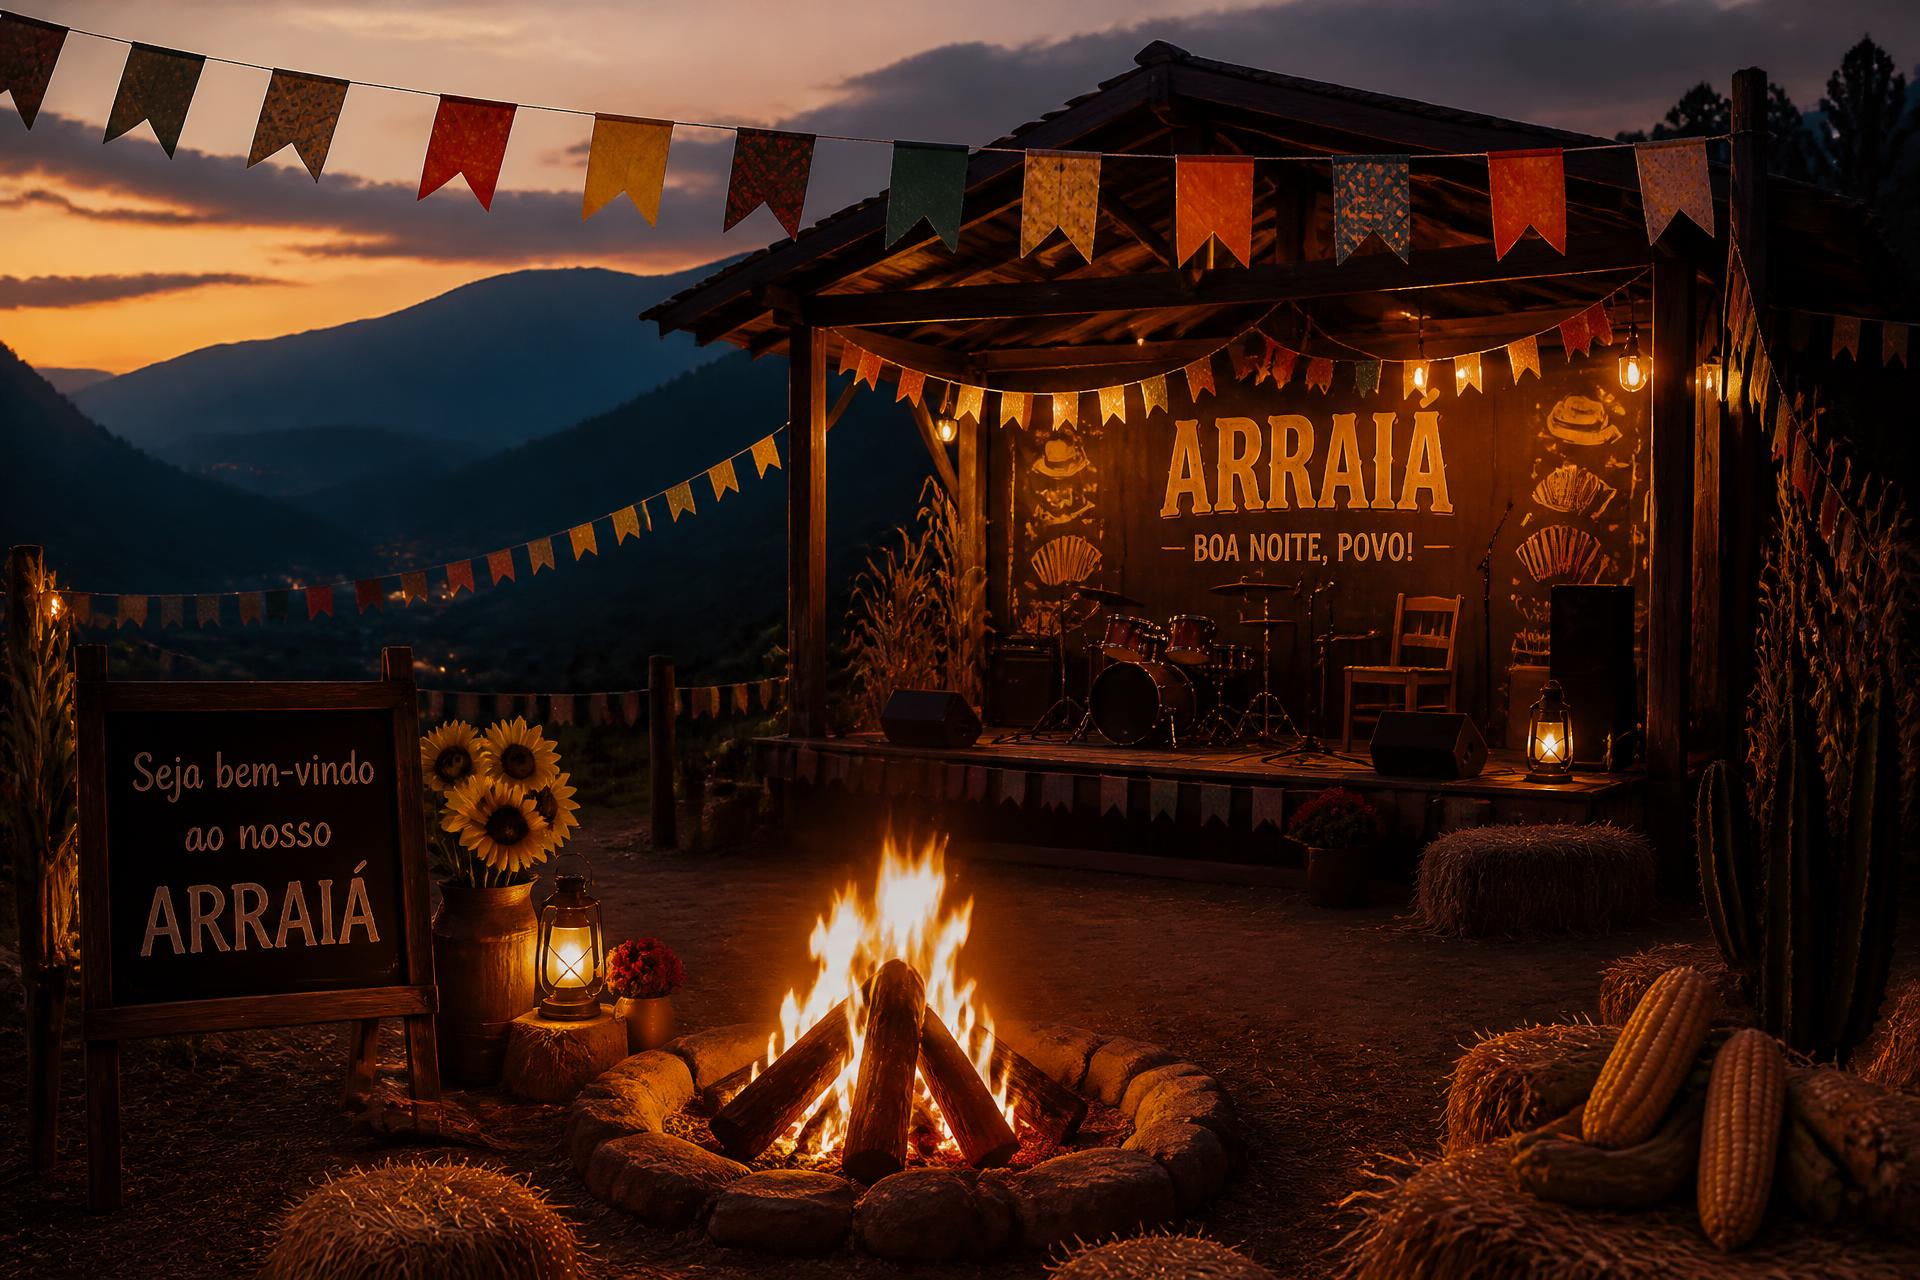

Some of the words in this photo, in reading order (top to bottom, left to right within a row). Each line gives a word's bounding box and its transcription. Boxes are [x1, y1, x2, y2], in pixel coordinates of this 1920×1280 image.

[1160, 387, 1454, 519] ARRAIÁ
[1194, 533, 1240, 562] BOA
[1250, 533, 1328, 566] NOITE,
[1338, 532, 1413, 562] POVO!
[132, 751, 204, 803] Seja
[216, 749, 375, 788] bem-vindo
[185, 826, 224, 852] ao
[239, 821, 332, 850] nosso
[140, 859, 381, 957] ARRAIÁ
